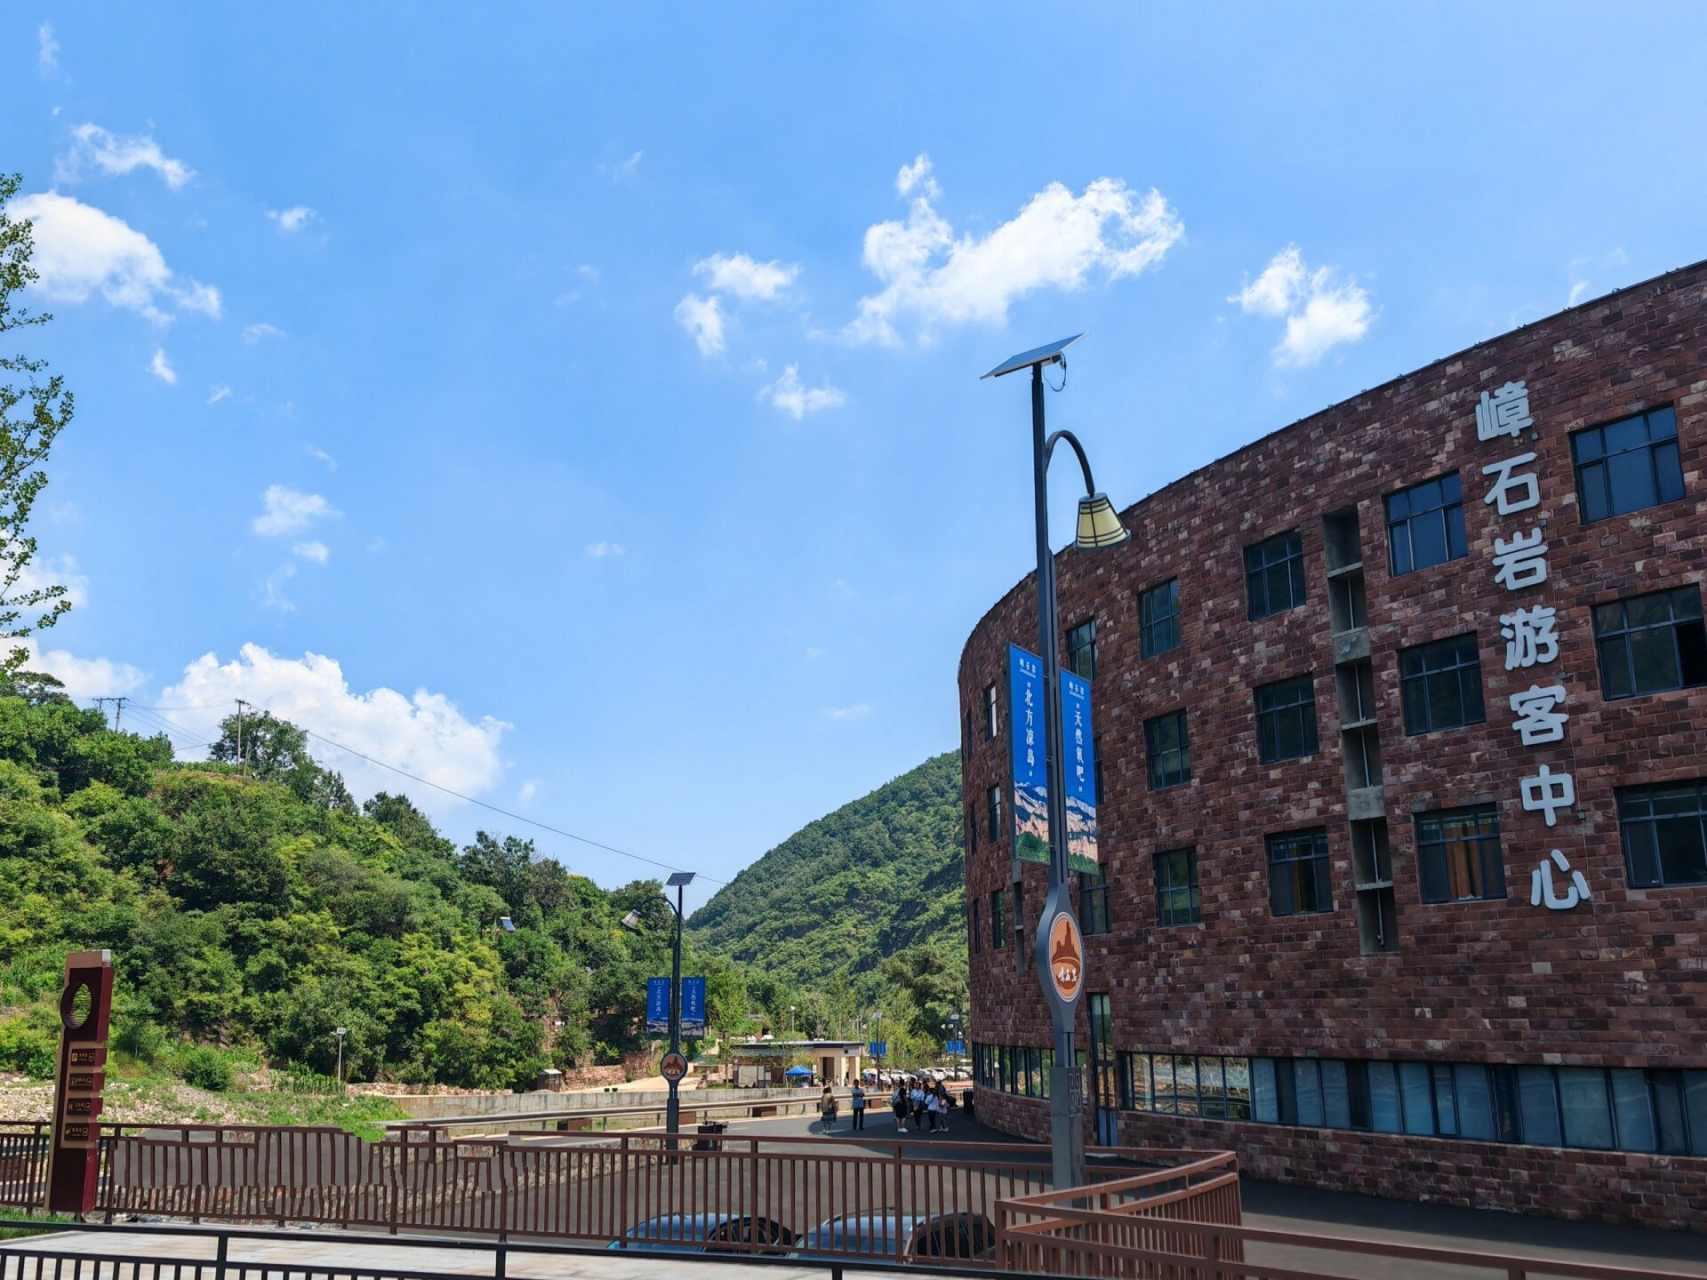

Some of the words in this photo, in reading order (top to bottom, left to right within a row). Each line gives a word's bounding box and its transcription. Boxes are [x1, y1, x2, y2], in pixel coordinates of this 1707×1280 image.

[1475, 380, 1592, 911] 嶂石岩游客中心
